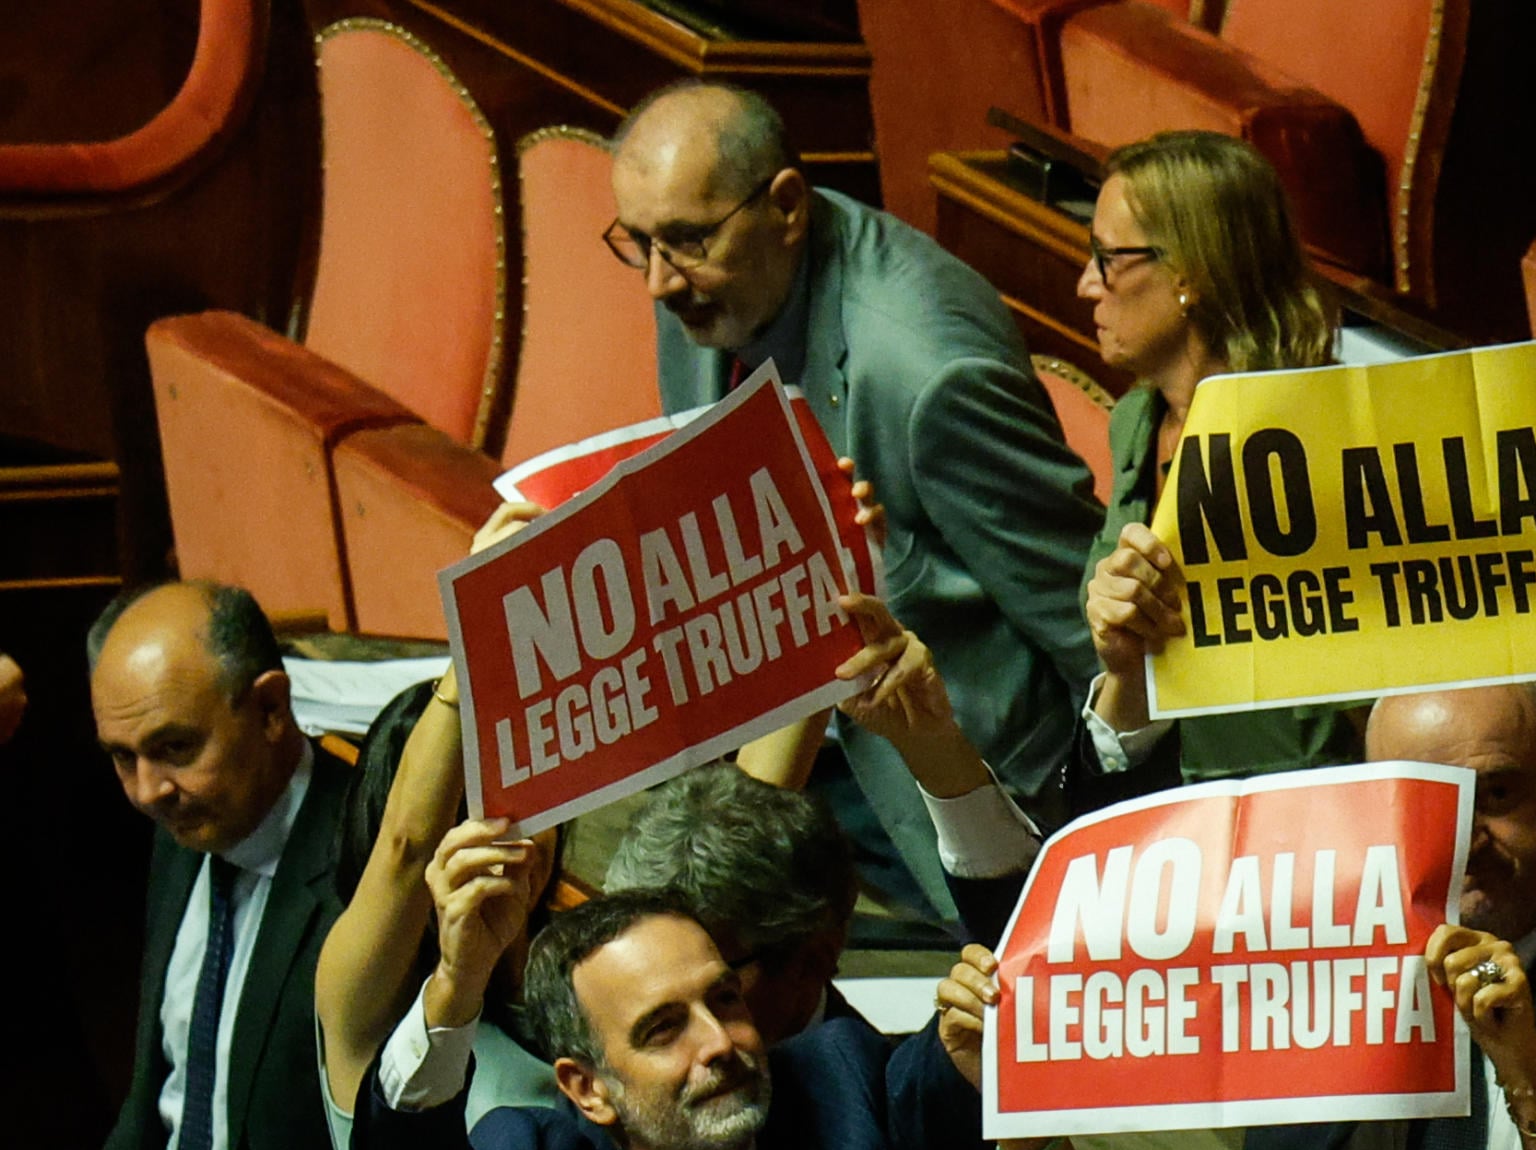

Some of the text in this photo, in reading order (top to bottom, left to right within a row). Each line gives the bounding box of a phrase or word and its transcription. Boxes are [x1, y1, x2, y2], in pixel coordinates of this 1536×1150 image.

[1177, 428, 1317, 565] NO
[502, 466, 805, 699] NO ALLA
[1187, 566, 1359, 648] LEGGE
[496, 551, 850, 789] LEGGE TRUFFA
[1047, 837, 1407, 963] NO ALLA
[1015, 955, 1436, 1063] LEGGE TRUFFA
